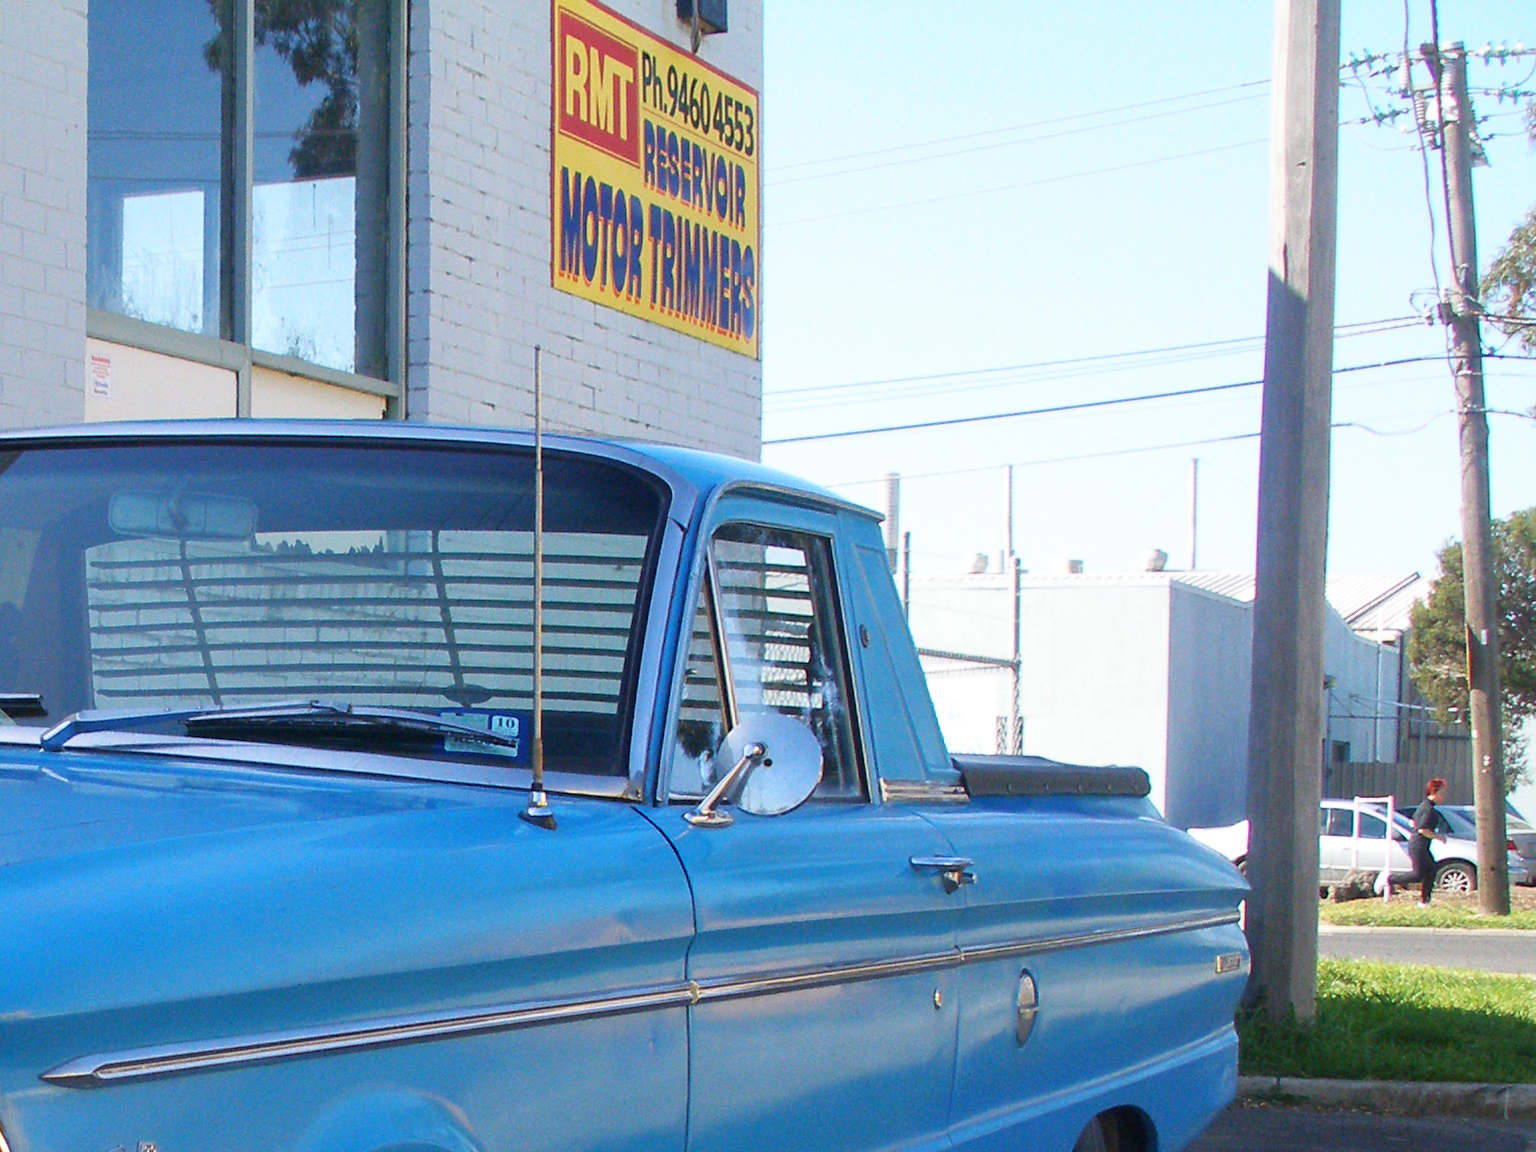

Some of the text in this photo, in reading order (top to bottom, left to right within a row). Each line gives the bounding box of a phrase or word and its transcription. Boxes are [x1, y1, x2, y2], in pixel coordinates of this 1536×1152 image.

[565, 34, 634, 142] RMT
[714, 91, 755, 157] 4553
[643, 119, 747, 233] RESERVOIR
[559, 166, 756, 343] MOTOR TRIMMERS
